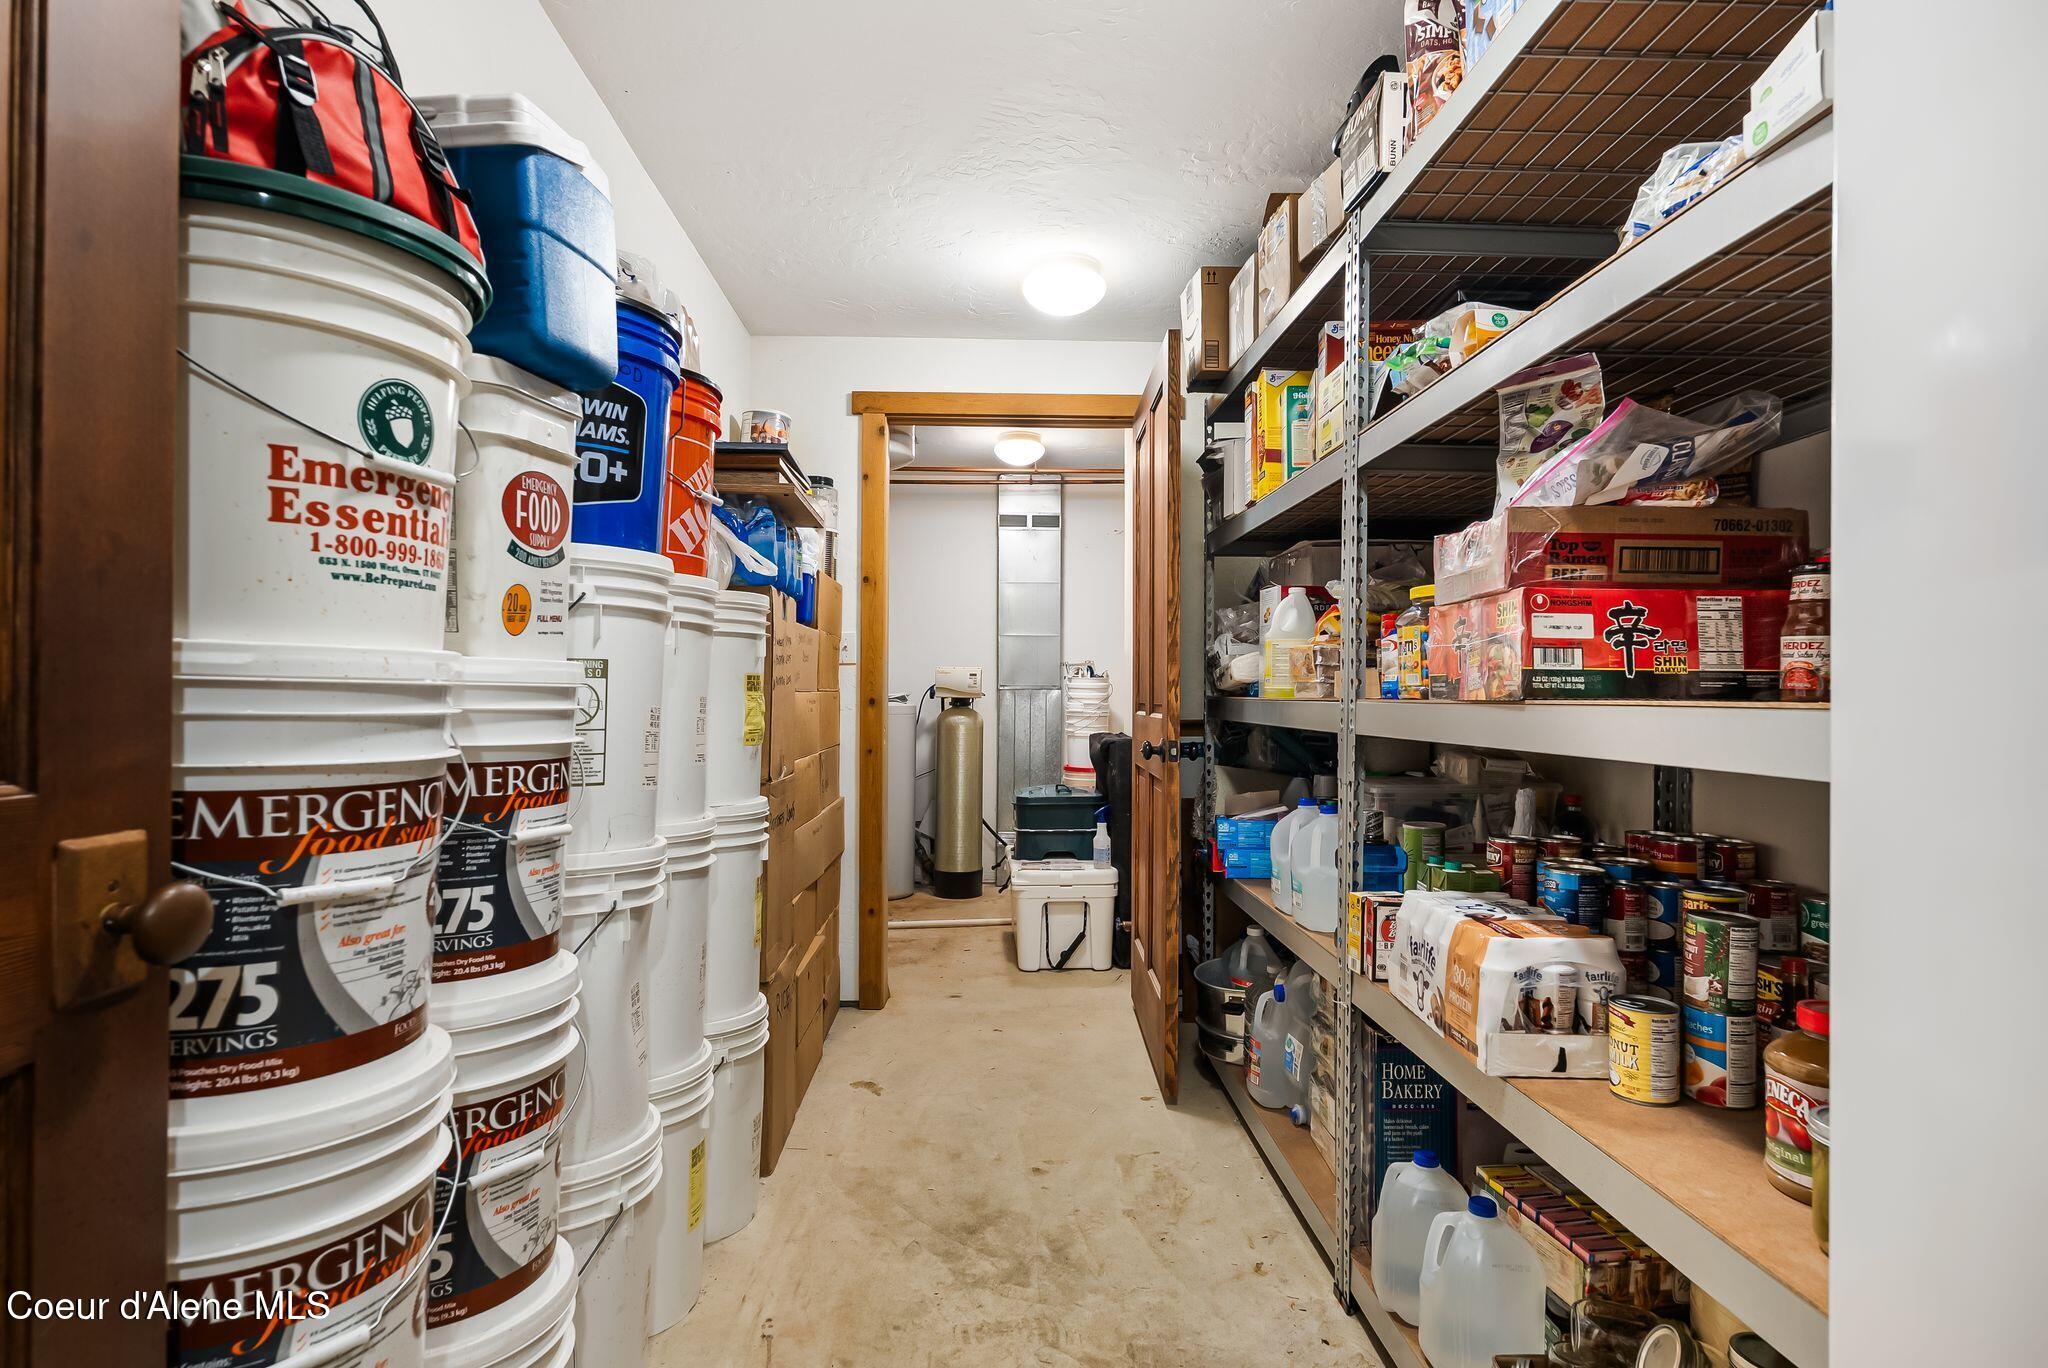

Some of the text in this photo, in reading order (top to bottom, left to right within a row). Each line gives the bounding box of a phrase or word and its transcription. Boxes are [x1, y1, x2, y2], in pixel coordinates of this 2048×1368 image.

[1343, 90, 1377, 146] BUNN
[1376, 334, 1400, 347] Honey
[366, 383, 405, 412] HELPING
[522, 475, 559, 497] EMERGENCY
[267, 485, 450, 549] Essential
[516, 489, 562, 535] FOOD
[530, 532, 551, 548] SUPPLY
[1548, 538, 1580, 555] Top
[331, 571, 437, 592] www.BePrepared.com
[508, 592, 520, 613] 20
[1550, 599, 1593, 607] NONGSHIM
[537, 614, 563, 623] FULL MENU
[1653, 638, 1688, 655] 라면
[1783, 641, 1825, 651] HERDEZ
[1654, 655, 1688, 668] SHIN
[1654, 666, 1688, 674] RAMYUN
[483, 783, 559, 823] food
[260, 815, 397, 876] food
[527, 868, 542, 878] Also
[338, 933, 361, 949] Also
[361, 927, 389, 944] great
[467, 957, 483, 965] Food
[482, 954, 497, 962] Mix
[1408, 935, 1437, 972] fairlife
[453, 966, 470, 976] 20.4
[469, 964, 482, 973] lbs
[168, 959, 279, 1033] 275
[216, 1064, 301, 1089] 20.4 lbs (9.3 kg)
[219, 1063, 239, 1076] Dry
[239, 1060, 263, 1072] Food
[263, 1057, 284, 1069] Mix
[1381, 1062, 1427, 1080] HOME
[1381, 1080, 1443, 1100] BAKERY
[493, 1202, 511, 1217] Also
[510, 1194, 532, 1211] great
